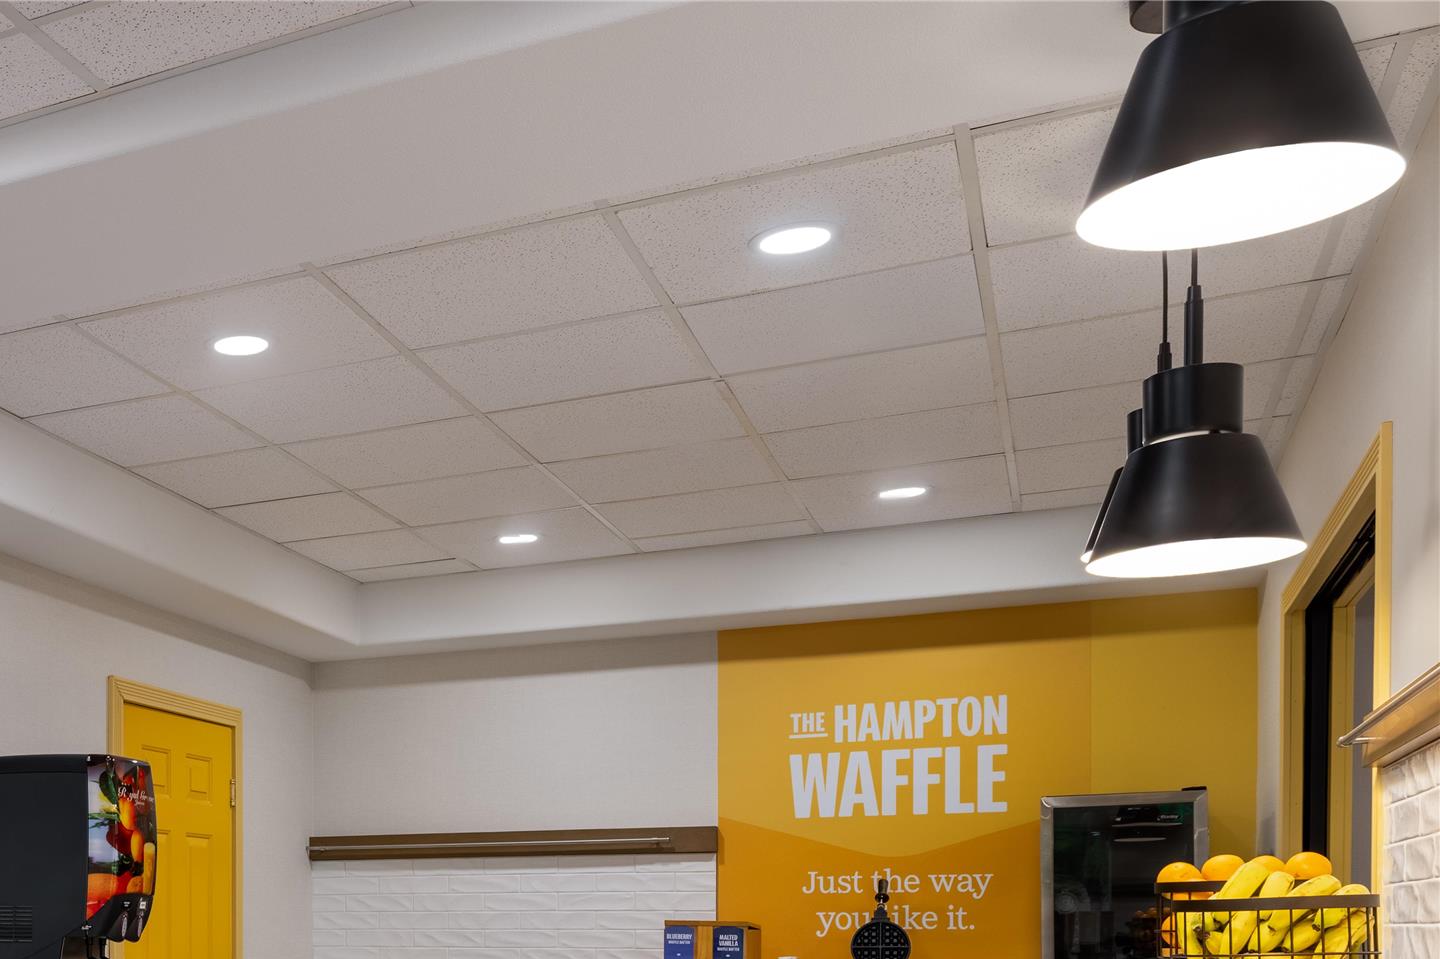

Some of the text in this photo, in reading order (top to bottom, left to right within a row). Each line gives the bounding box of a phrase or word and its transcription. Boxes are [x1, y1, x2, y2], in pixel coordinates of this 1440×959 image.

[790, 694, 1009, 743] THE HAMPTON
[789, 743, 1009, 819] WAFFLE
[802, 868, 994, 899] Just the way
[888, 904, 938, 930] ike
[947, 904, 976, 930] it.
